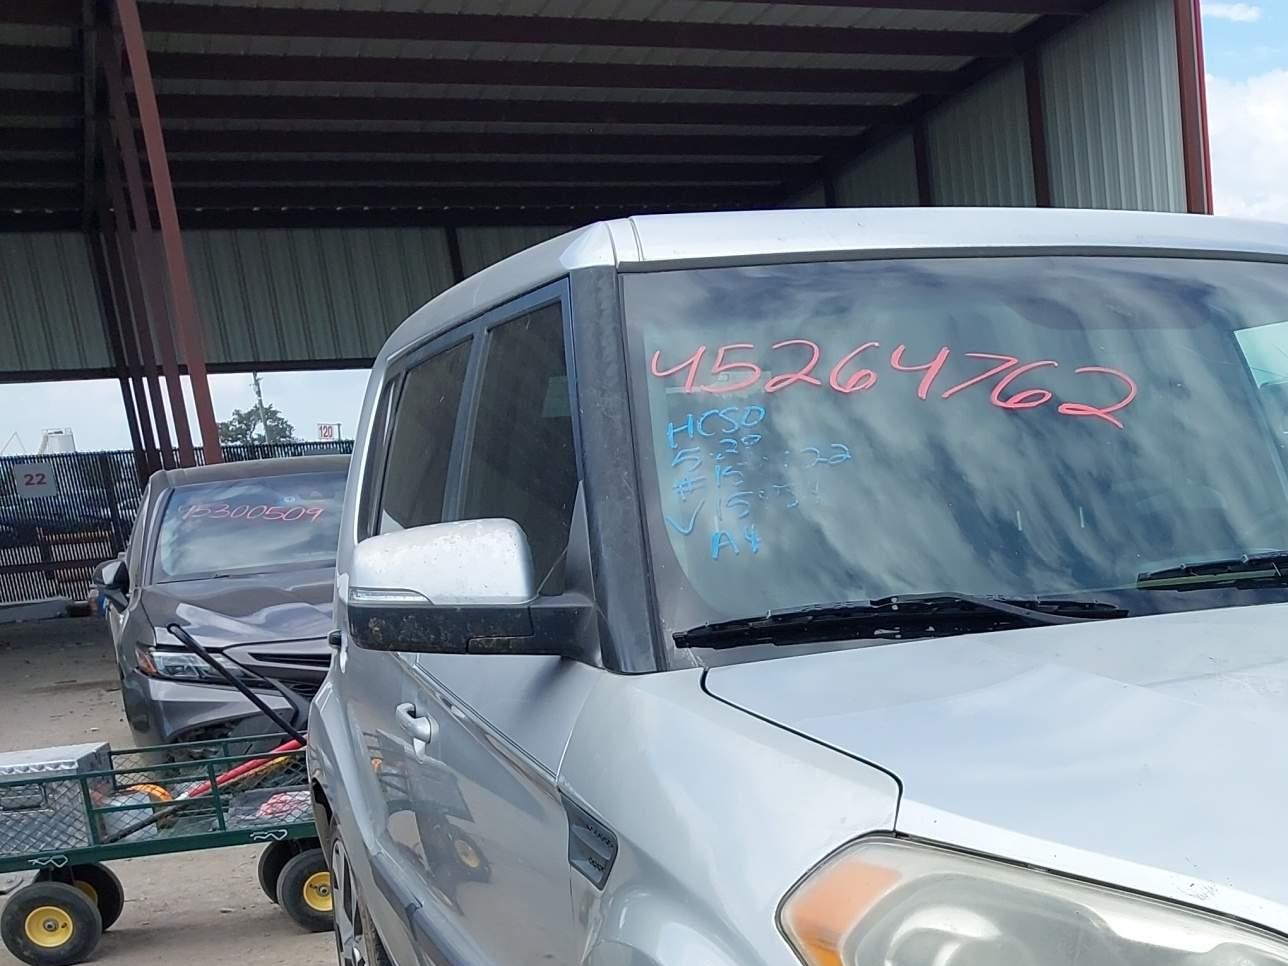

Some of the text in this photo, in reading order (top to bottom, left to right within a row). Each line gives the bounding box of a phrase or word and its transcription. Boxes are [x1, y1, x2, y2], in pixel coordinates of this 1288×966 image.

[651, 339, 1137, 428] 45264762
[319, 425, 333, 438] 120
[23, 472, 48, 487] 22
